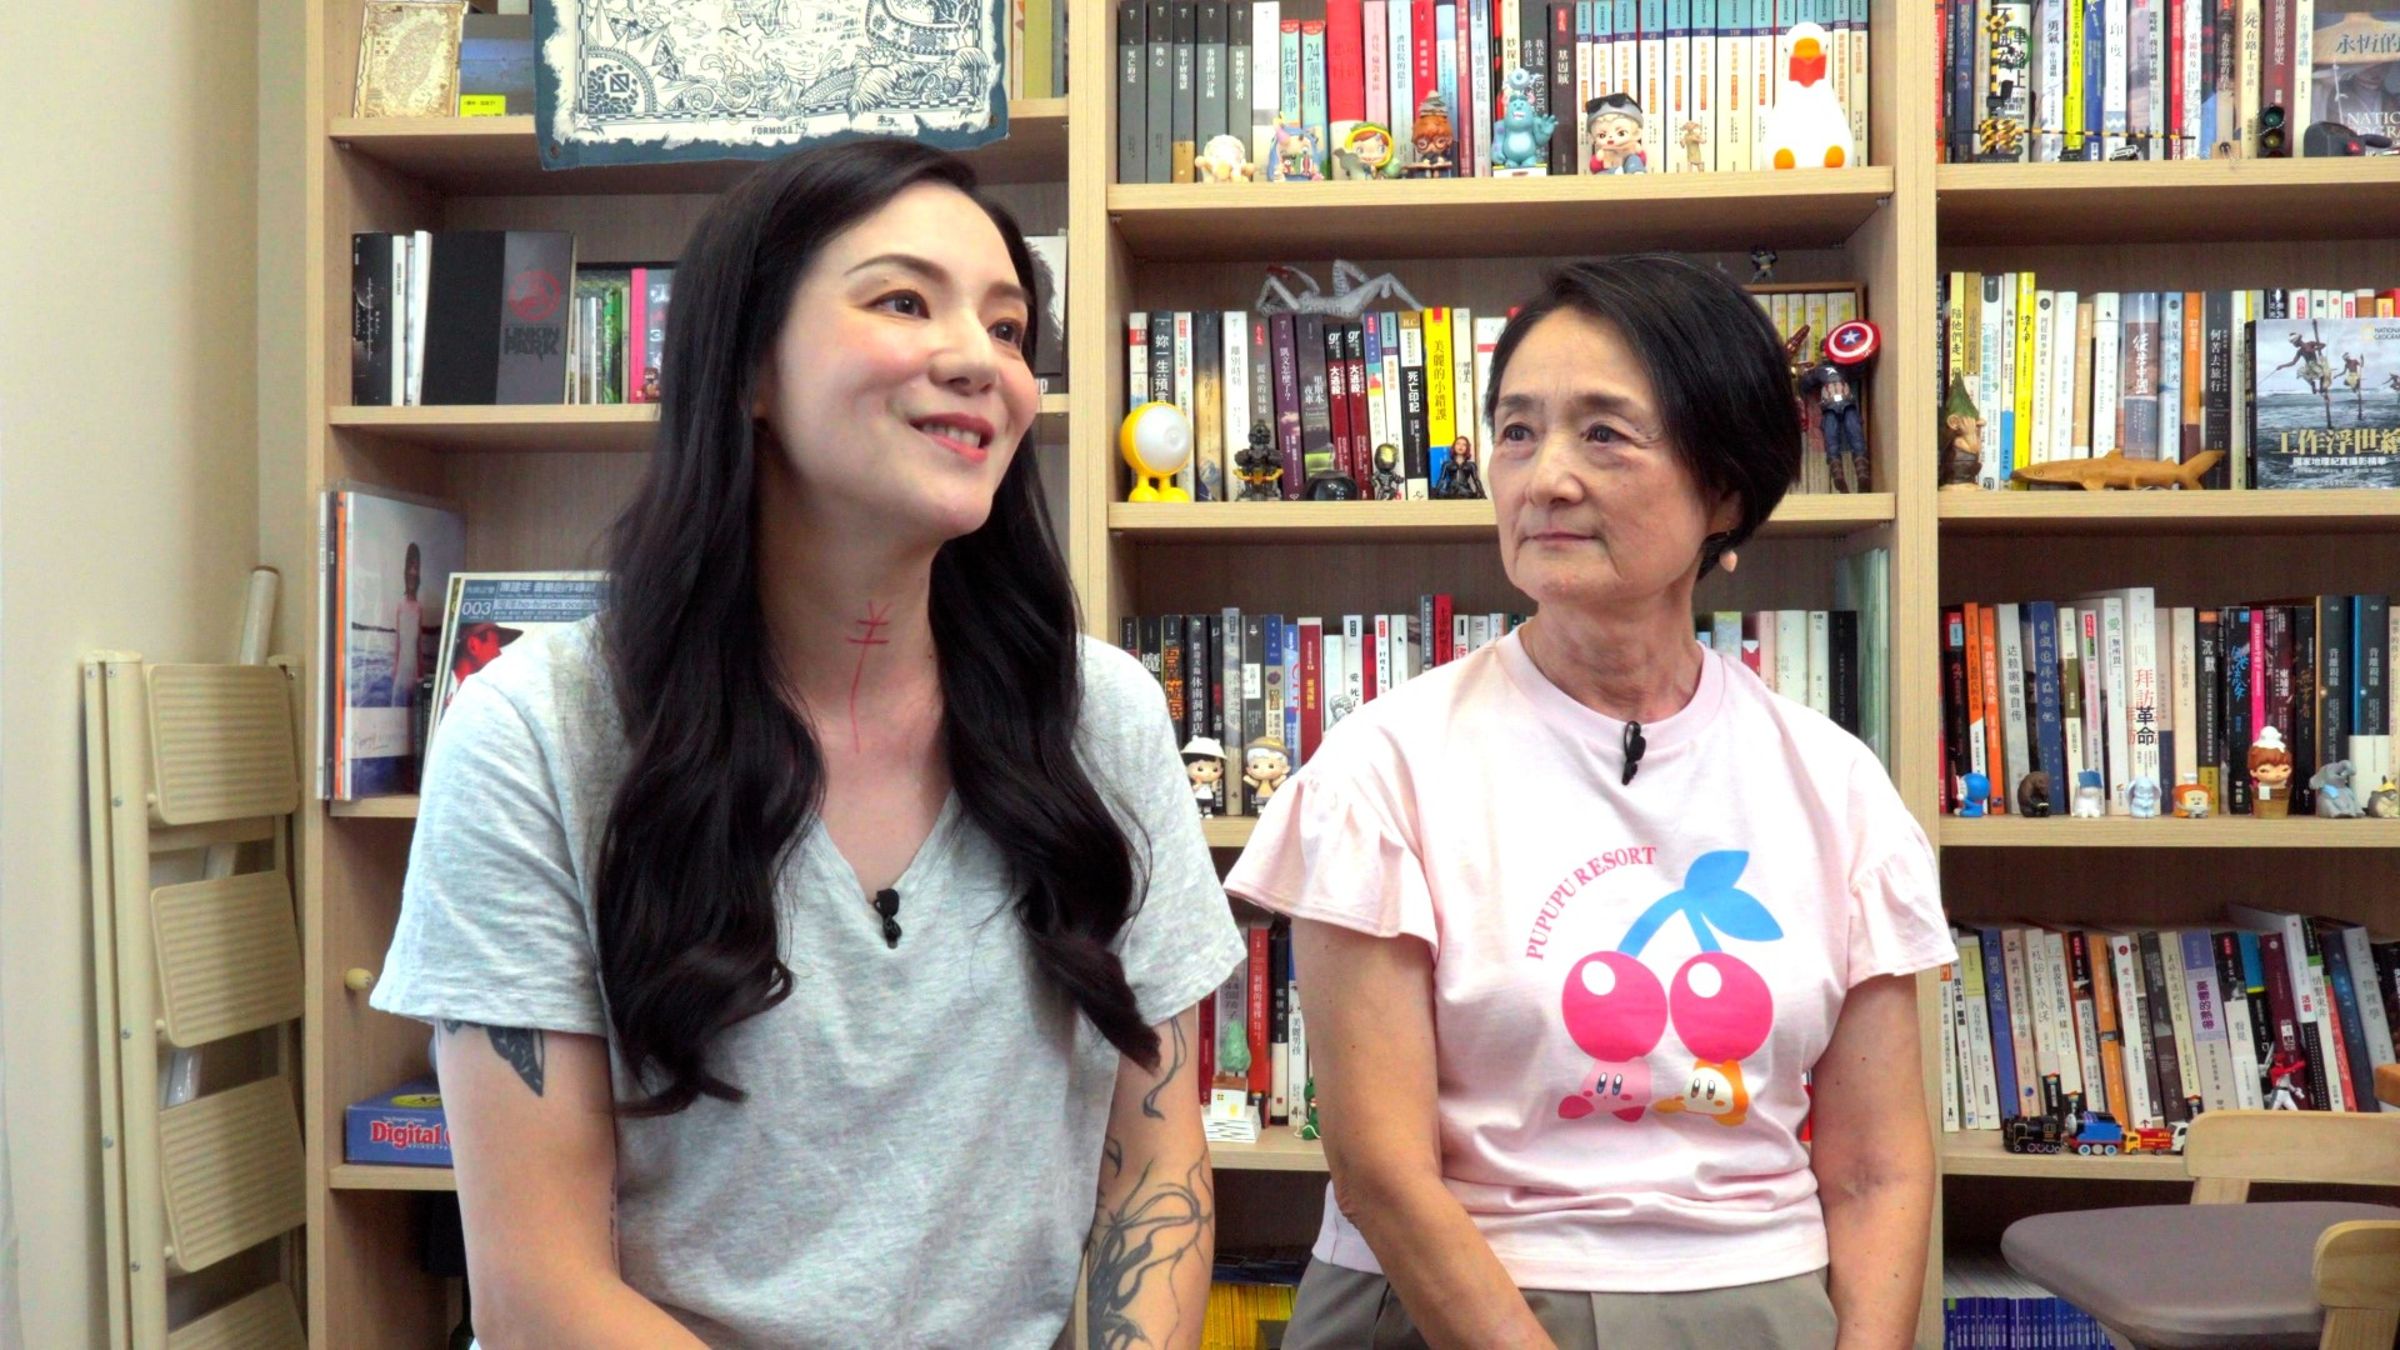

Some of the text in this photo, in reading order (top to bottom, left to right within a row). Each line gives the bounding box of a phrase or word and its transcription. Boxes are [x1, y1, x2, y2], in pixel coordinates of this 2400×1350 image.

[752, 126, 793, 135] FORMOSA
[504, 327, 559, 342] LINKIN
[504, 342, 558, 362] PARK
[1407, 371, 1420, 413] 死亡印記
[462, 601, 492, 615] 003
[1525, 846, 1657, 961] PUPUPU RESORT
[370, 1119, 442, 1151] Digital
